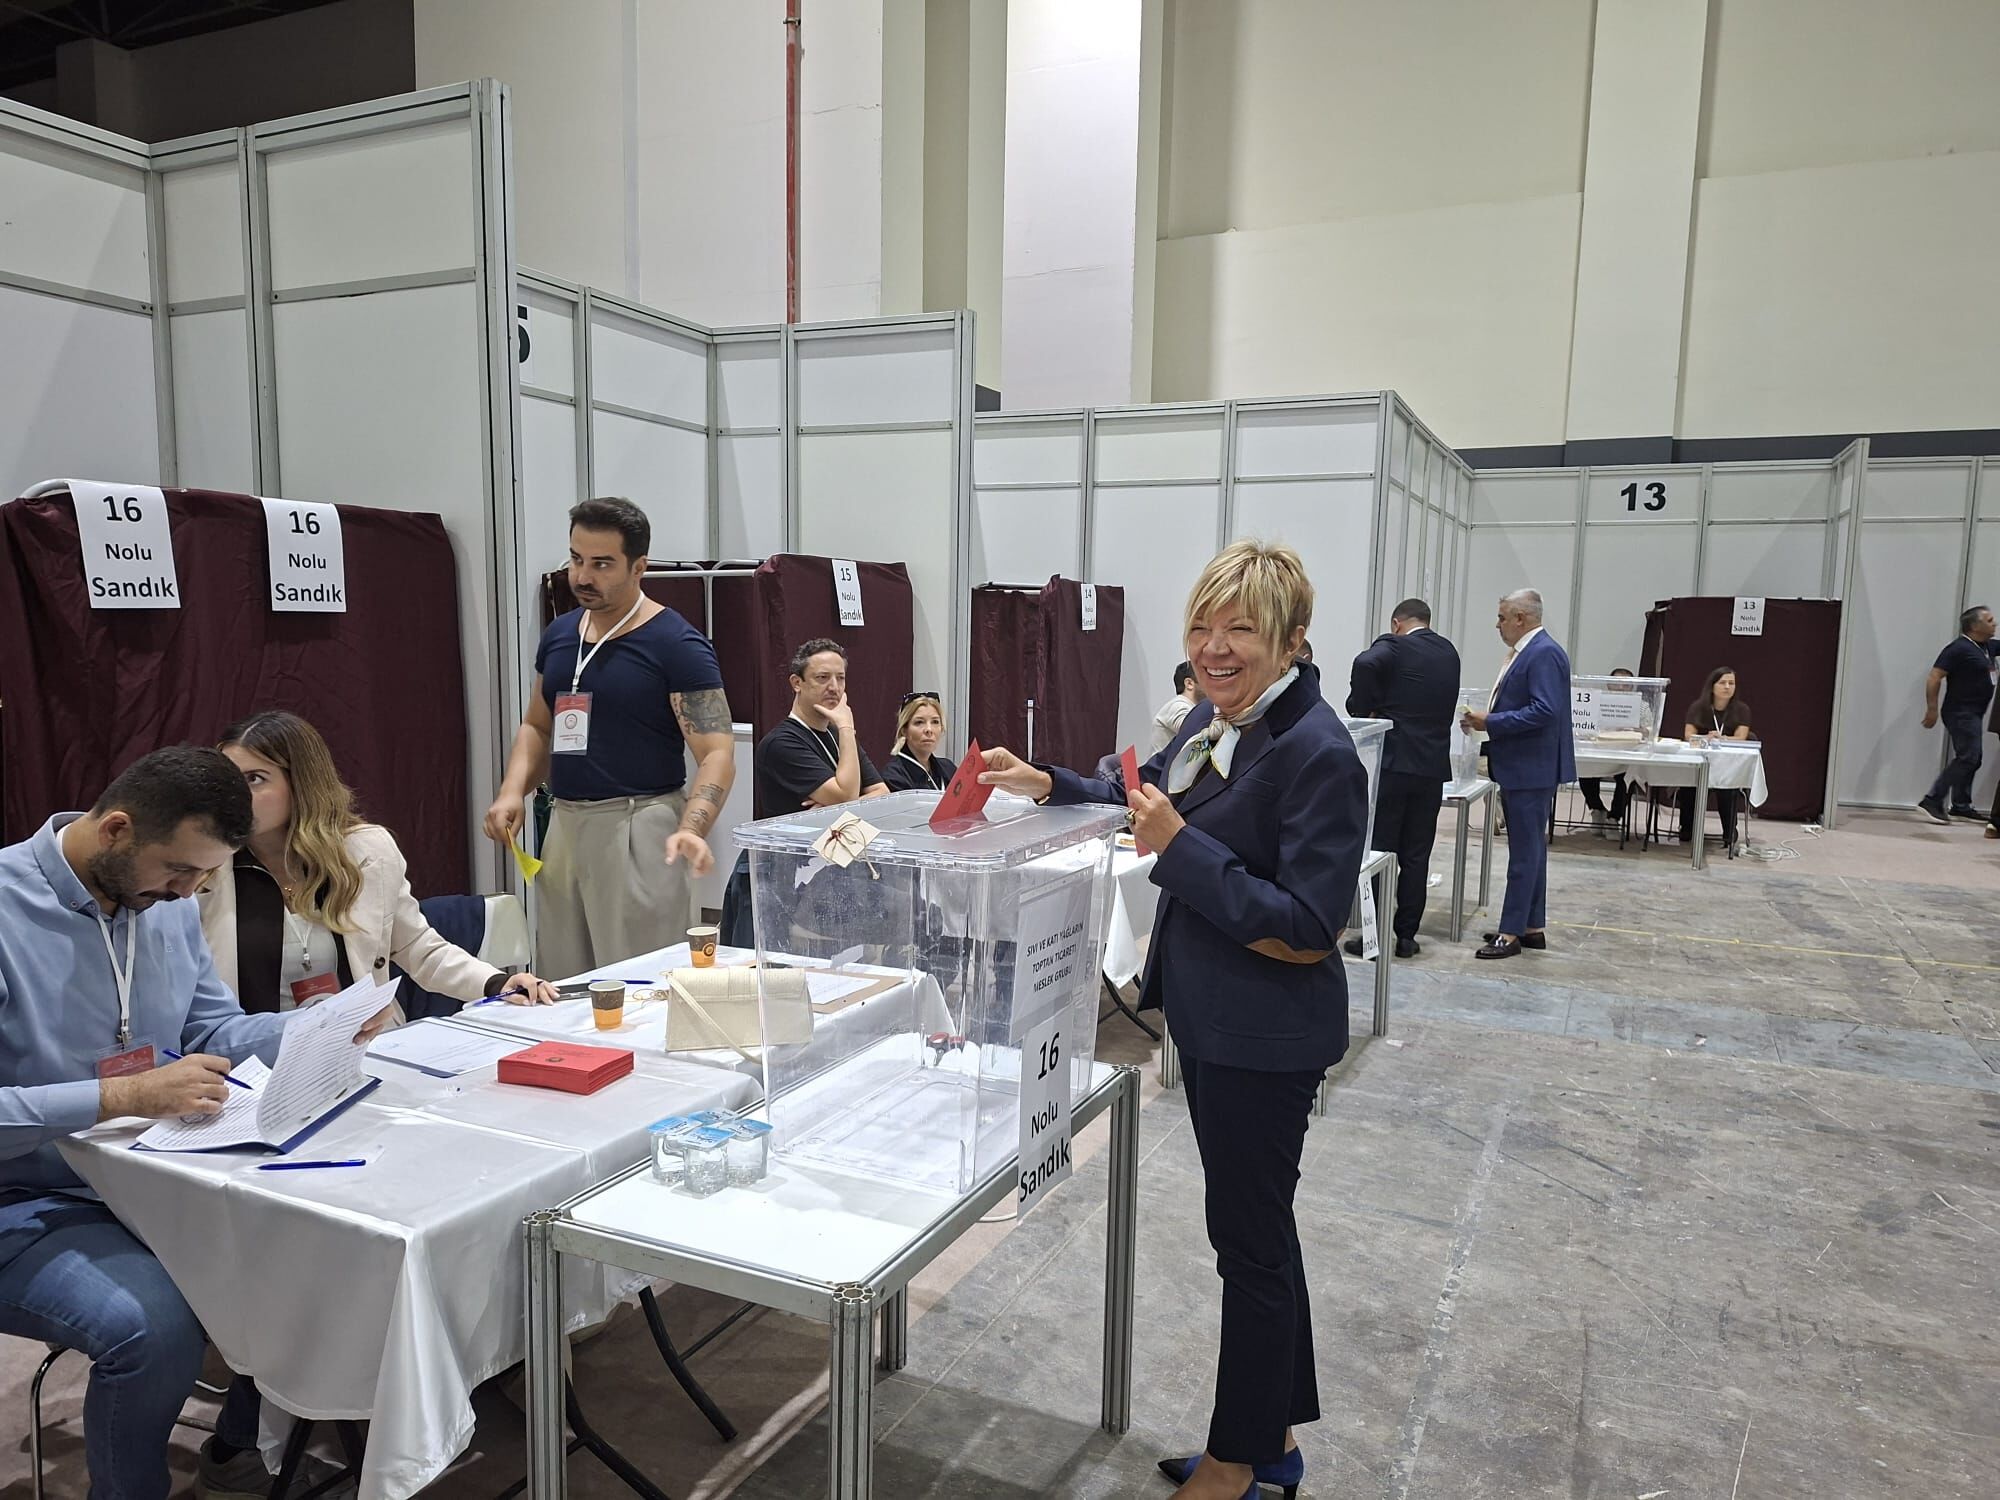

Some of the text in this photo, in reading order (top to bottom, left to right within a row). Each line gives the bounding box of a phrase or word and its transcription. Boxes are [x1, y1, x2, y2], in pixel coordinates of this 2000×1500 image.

[1620, 482, 1667, 511] 13
[102, 495, 143, 522] 16
[288, 510, 321, 535] 16
[105, 543, 152, 561] Nolu
[288, 553, 327, 569] Nolu
[840, 567, 852, 582] 15
[92, 577, 175, 598] Sandık
[275, 583, 342, 603] Sandık
[1743, 600, 1756, 610] 13
[1576, 692, 1591, 703] 13
[1038, 1031, 1060, 1081] 16
[1031, 1100, 1058, 1139] Nolu
[1020, 1136, 1070, 1203] Sandık
